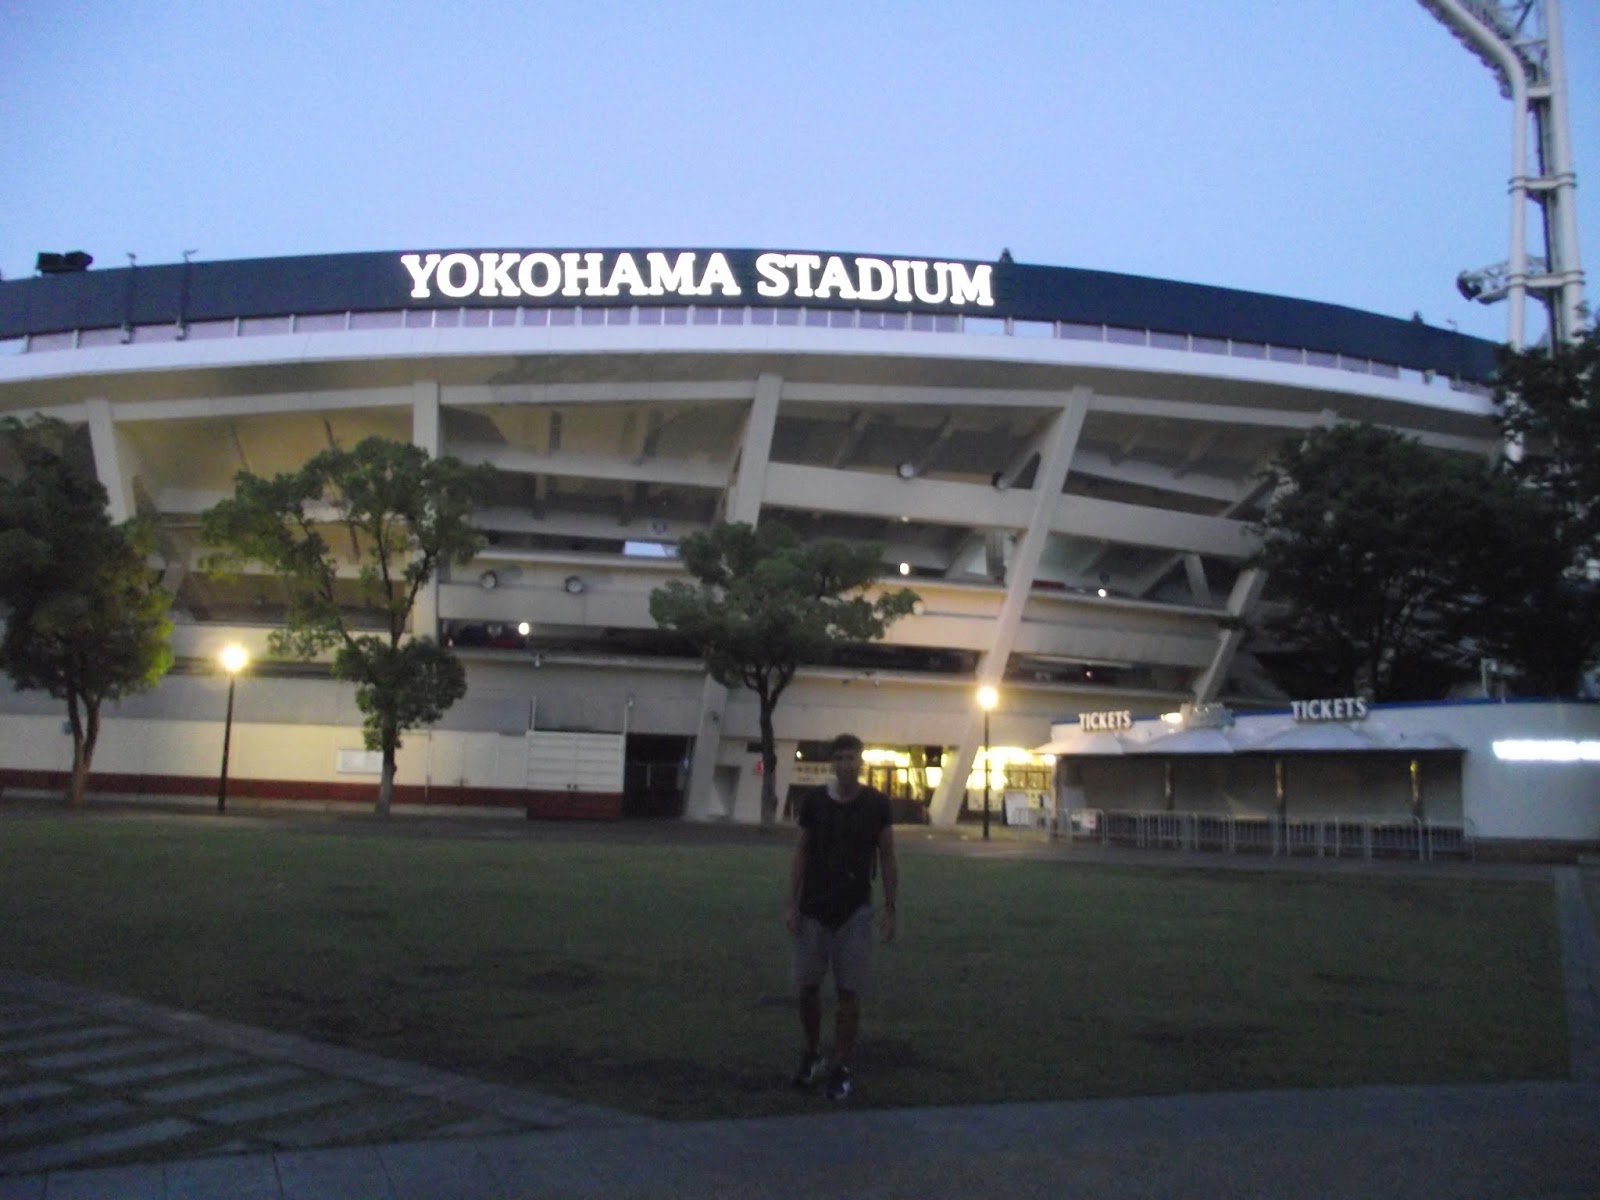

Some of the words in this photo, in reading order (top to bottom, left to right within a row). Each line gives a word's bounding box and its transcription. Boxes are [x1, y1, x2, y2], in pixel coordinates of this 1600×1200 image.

[401, 253, 741, 299] YOKOHAMA
[755, 253, 995, 306] STADIUM
[1079, 710, 1132, 731] TICKETS
[1291, 697, 1367, 721] TICKETS
